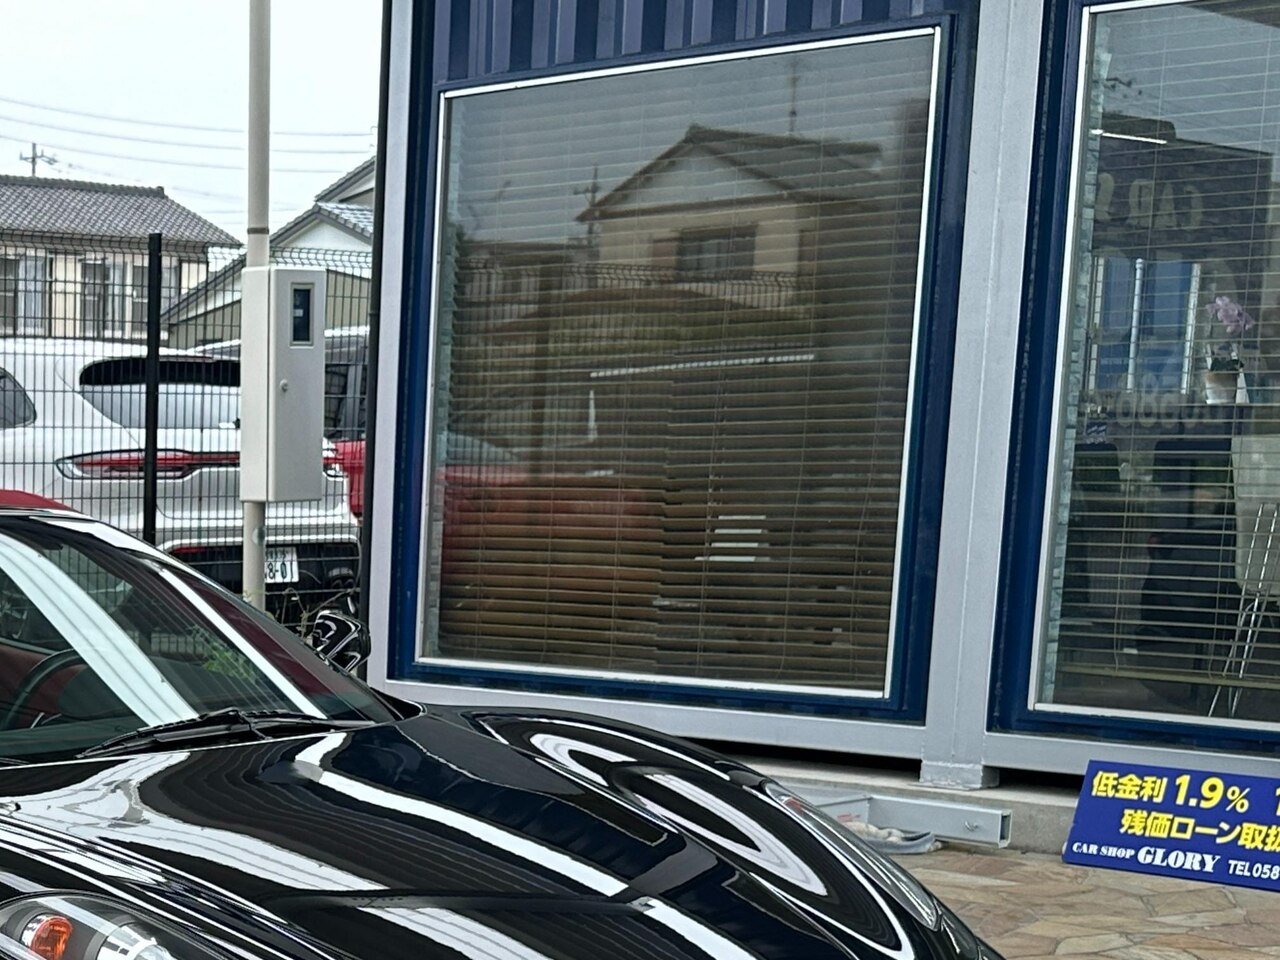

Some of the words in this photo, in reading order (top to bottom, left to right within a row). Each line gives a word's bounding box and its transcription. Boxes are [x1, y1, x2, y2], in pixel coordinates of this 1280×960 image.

[1091, 771, 1168, 803] 低金利
[1175, 774, 1251, 813] 1.9%
[1072, 842, 1098, 855] CAR
[1099, 846, 1135, 859] SHOP
[1137, 846, 1220, 873] GLORY
